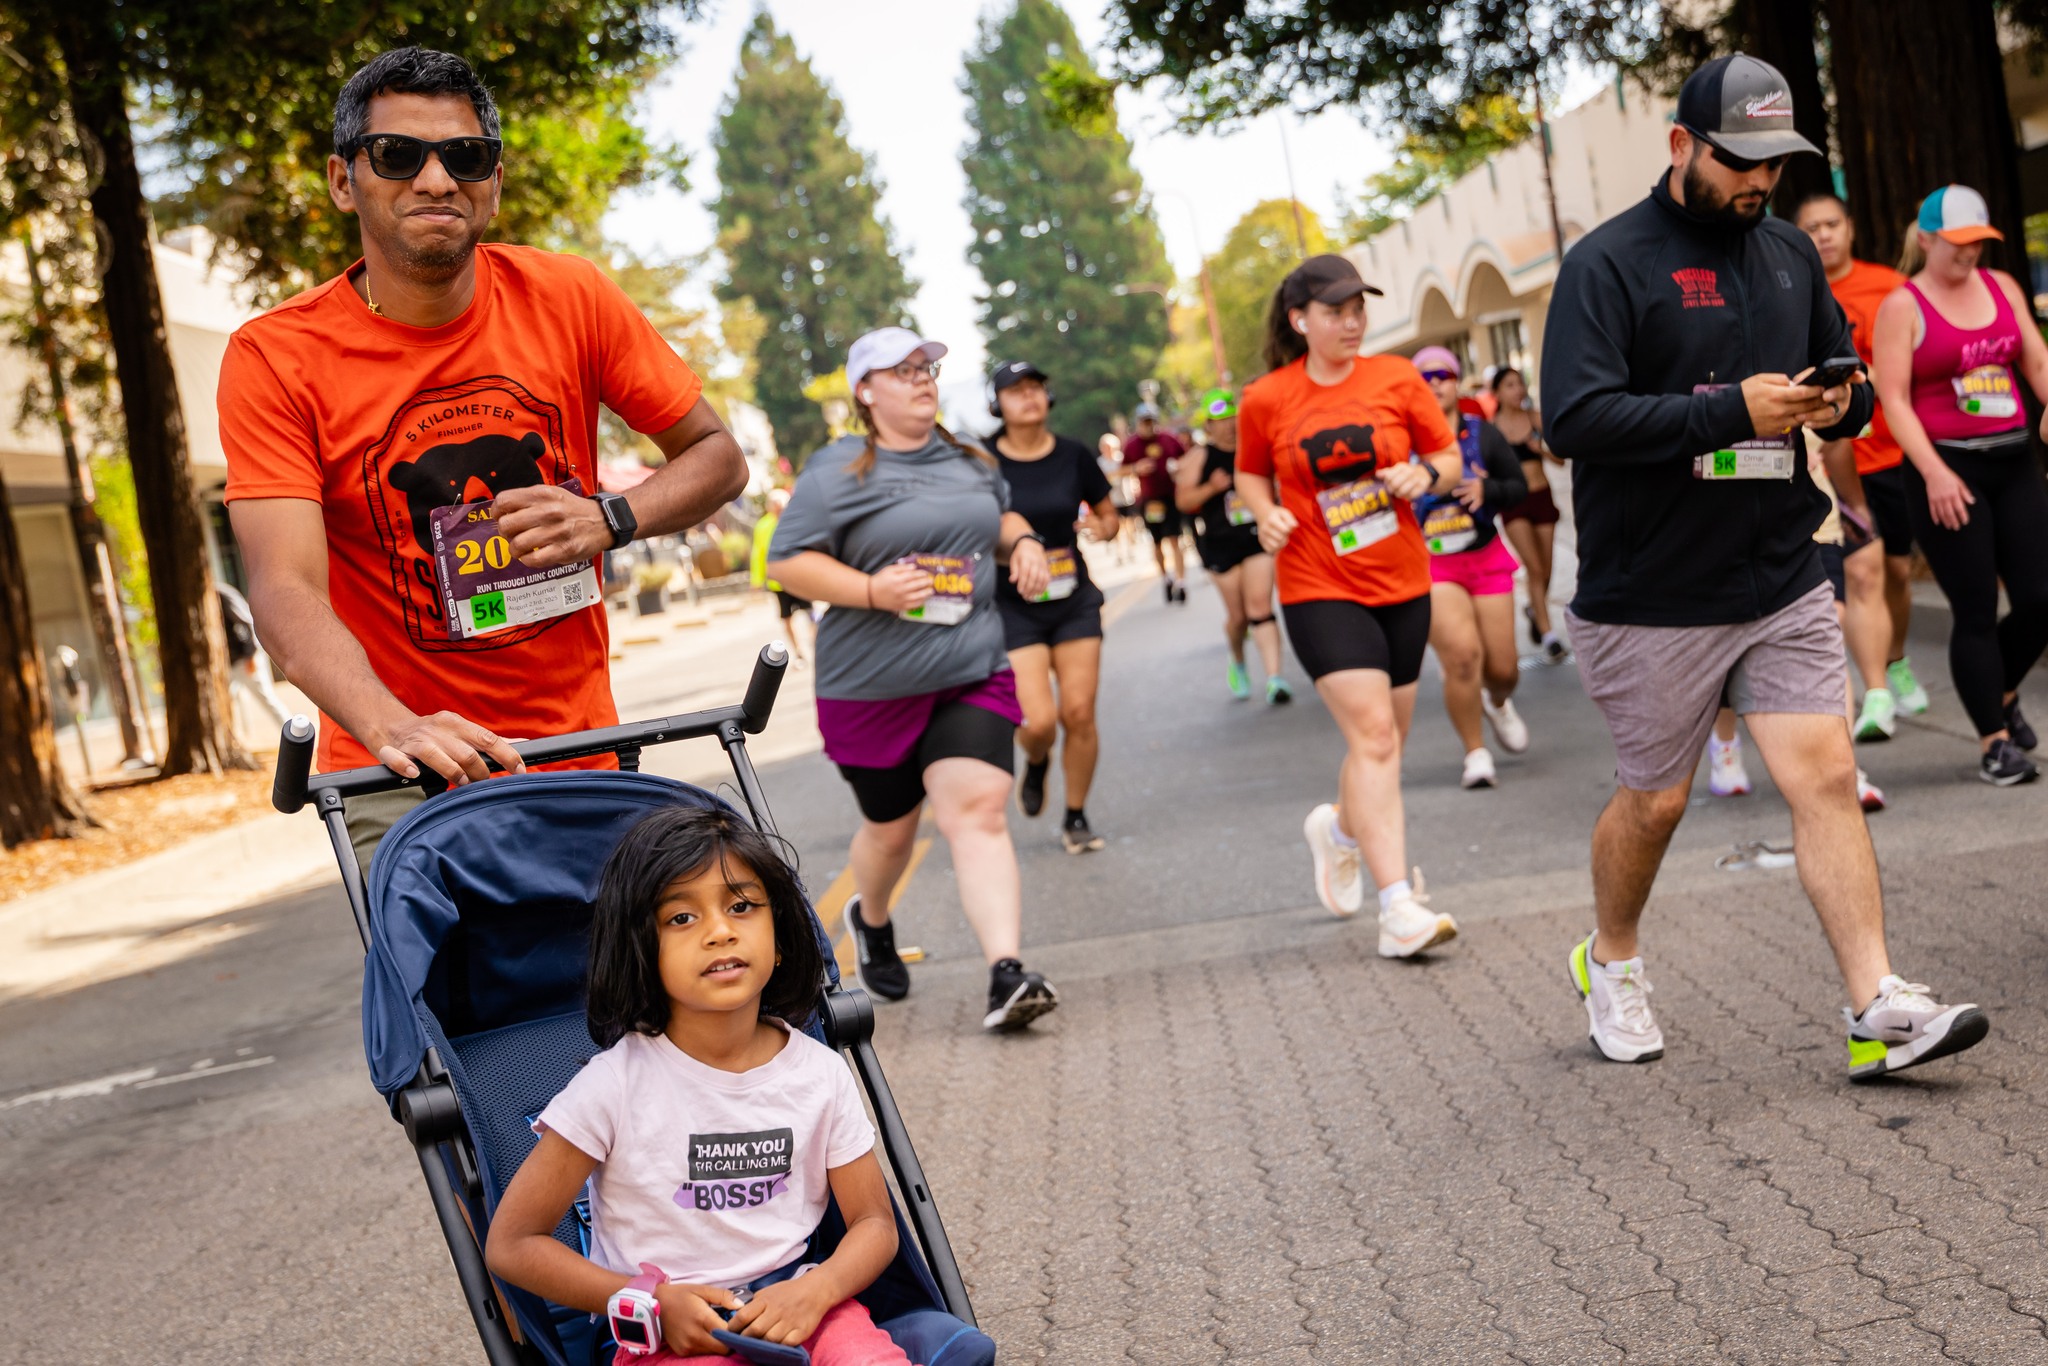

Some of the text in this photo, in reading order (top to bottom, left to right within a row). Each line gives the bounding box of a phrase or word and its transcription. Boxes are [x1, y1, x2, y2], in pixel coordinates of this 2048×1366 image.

[405, 404, 515, 443] 5 KILOMETER
[437, 422, 484, 439] FINISHER
[1714, 455, 1735, 471] 5K
[1743, 454, 1765, 463] Omar
[476, 582, 493, 594] RUN
[493, 576, 527, 591] THROUGH
[547, 562, 578, 579] COUNTRY!
[506, 585, 557, 604] Rajesh Kumar
[474, 598, 506, 621] 5K
[508, 602, 528, 613] August
[695, 1138, 786, 1159] THANK YOU
[714, 1158, 768, 1172] CALLING
[770, 1155, 787, 1167] ME
